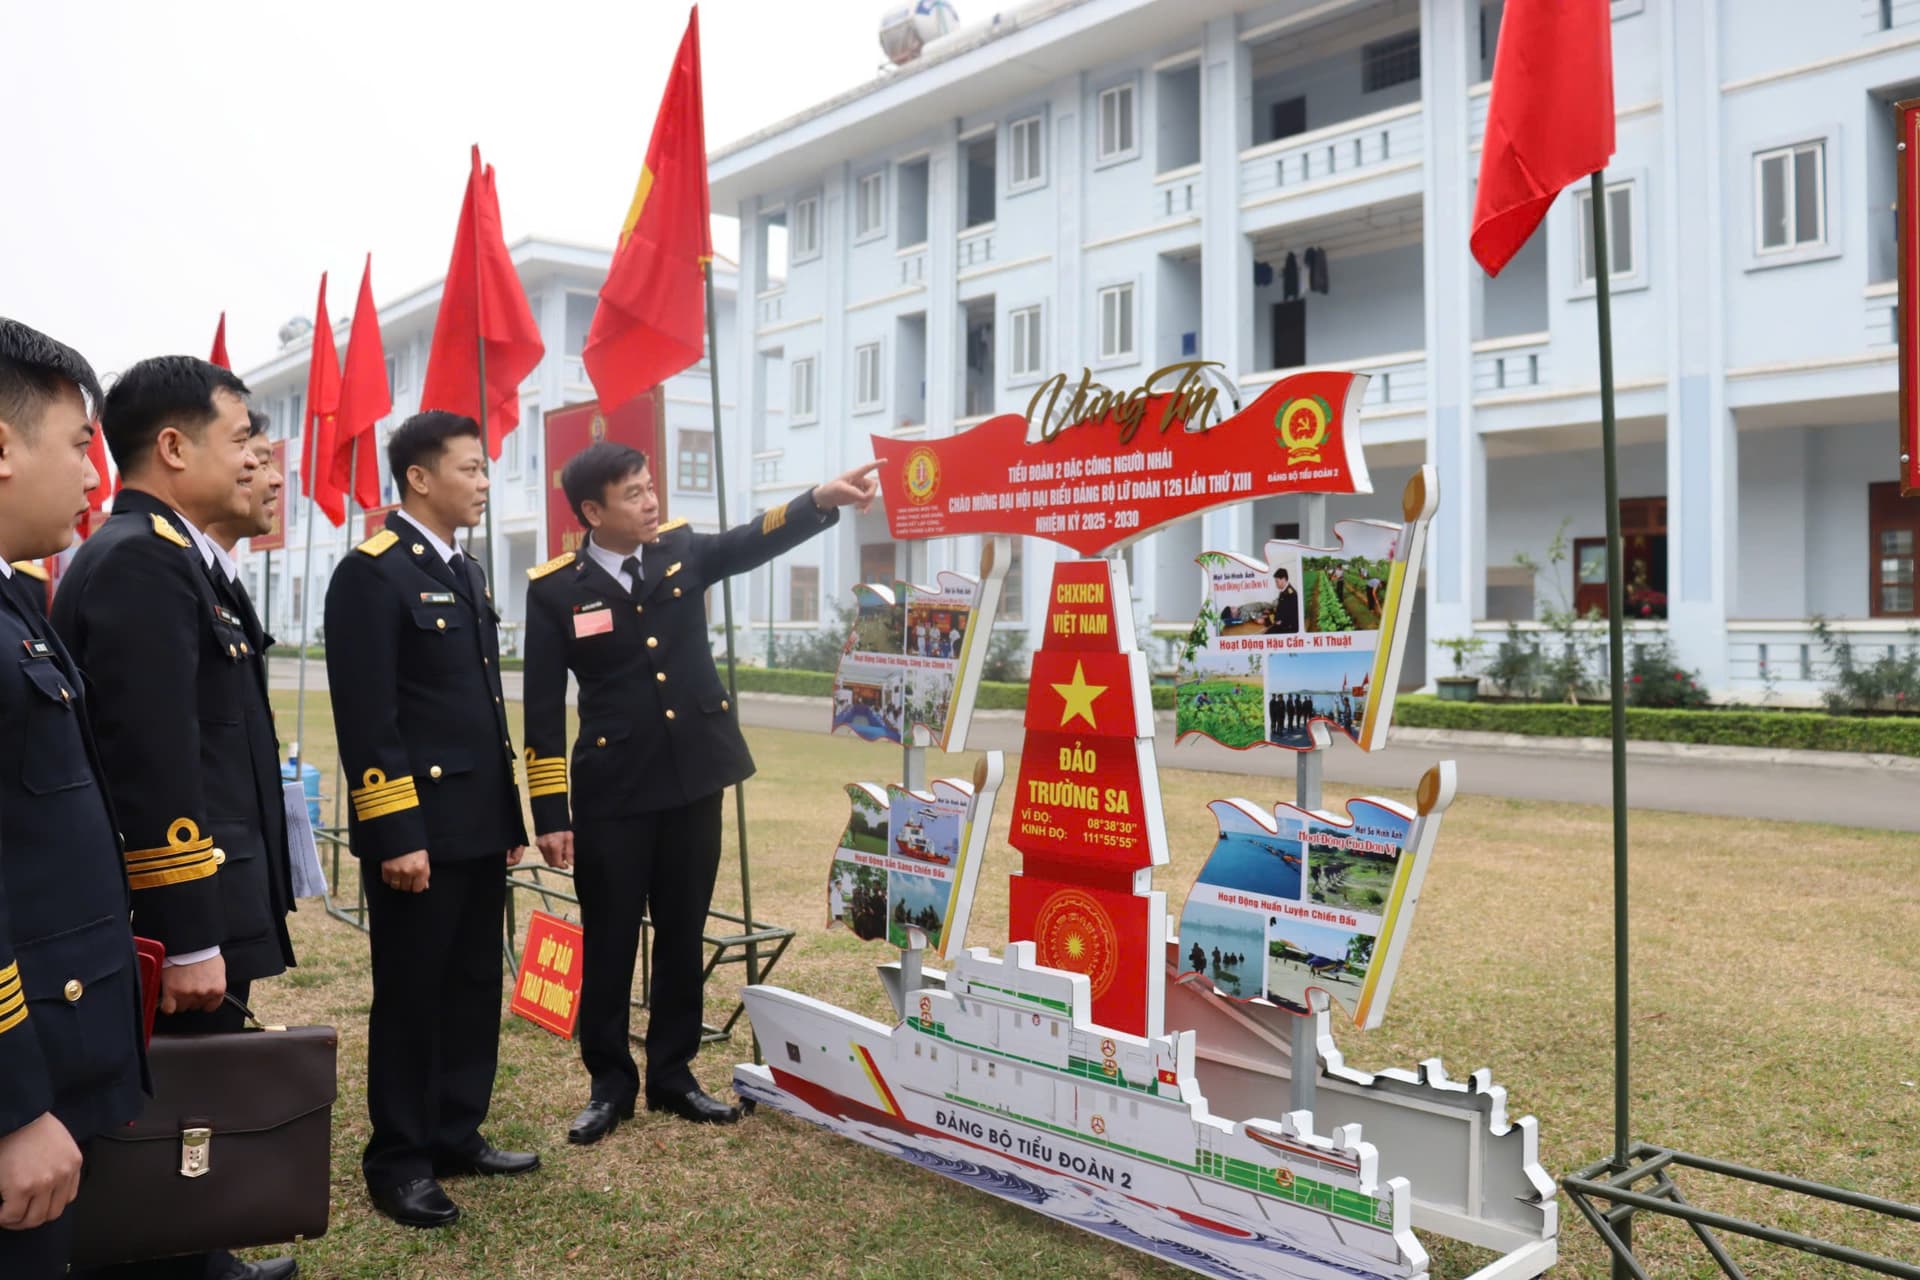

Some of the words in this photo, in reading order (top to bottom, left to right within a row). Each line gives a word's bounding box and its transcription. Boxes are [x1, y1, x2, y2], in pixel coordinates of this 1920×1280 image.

[1145, 361, 1225, 433] Tin
[1008, 460, 1027, 483] TIỂU
[1029, 460, 1054, 481] ĐOÀN
[1056, 462, 1062, 479] 2
[1064, 457, 1082, 481] ĐẶC
[1085, 454, 1111, 476] CÔNG
[1114, 450, 1144, 473] NGƯỜI
[1147, 447, 1172, 470] NHÁI
[1288, 470, 1298, 482] BỘ
[1299, 467, 1312, 479] TIỂU
[1313, 467, 1332, 478] ĐOÀN
[1334, 468, 1338, 477] 2
[949, 494, 970, 513] CHÀO
[972, 492, 997, 512] MỪNG
[999, 493, 1014, 512] ĐẠI
[1016, 488, 1031, 511] HỘI
[1032, 490, 1047, 510] ĐẠI
[1050, 482, 1070, 505] BIỂU
[1073, 480, 1100, 504] ĐẢNG
[1102, 480, 1115, 505] BỘ
[1118, 480, 1130, 500] LỮ
[1132, 477, 1160, 499] ĐOÀN
[1163, 478, 1182, 497] 126
[1185, 470, 1206, 495] LẦN
[1209, 470, 1230, 493] THỨ
[1232, 472, 1252, 491] XIII
[1036, 512, 1065, 535] NHIỆM
[1068, 510, 1080, 531] KỲ
[1082, 512, 1105, 530] 2025
[1114, 510, 1139, 528] 2030
[1057, 584, 1104, 603] CHXHCN
[1053, 610, 1077, 638] VIỆT
[1080, 614, 1107, 634] NAM
[1060, 741, 1096, 773] ĐẢO
[1029, 779, 1099, 810] TRƯỜNG
[1104, 789, 1129, 814] SA
[1022, 823, 1046, 836] KINH
[1218, 892, 1236, 904] Hoạt
[1238, 895, 1259, 908] Động
[1261, 899, 1281, 912] Huấn
[1284, 904, 1309, 918] Luyện
[1312, 909, 1336, 922] Chiến
[1339, 914, 1356, 926] Đấu
[936, 1110, 984, 1138] ĐẢNG
[989, 1128, 1012, 1152] BỘ
[1018, 1136, 1052, 1162] TIỂU
[1058, 1152, 1114, 1184] ĐOÀN
[1121, 1173, 1132, 1189] 2
